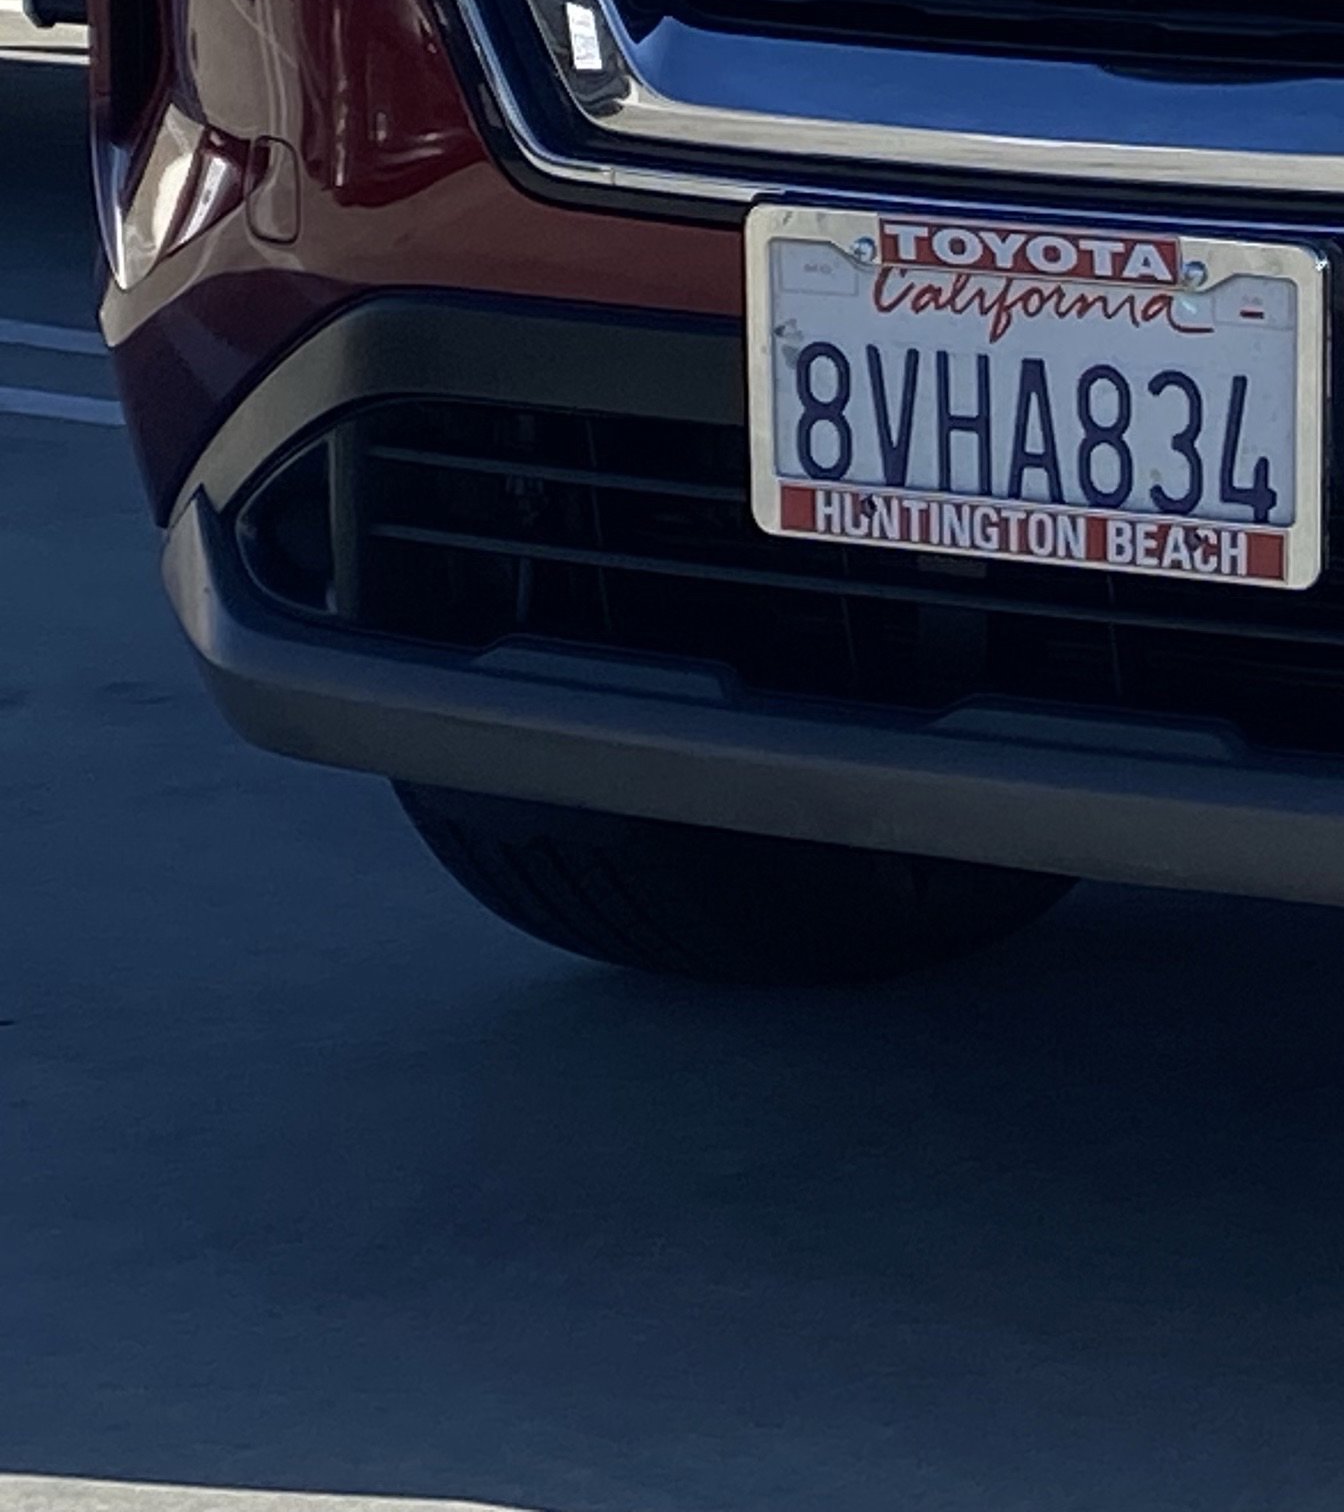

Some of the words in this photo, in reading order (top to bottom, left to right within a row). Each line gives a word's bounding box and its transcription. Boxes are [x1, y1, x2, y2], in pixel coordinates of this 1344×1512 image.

[882, 223, 1177, 282] TOYOTA
[873, 266, 1214, 344] California
[795, 340, 1278, 524] 8VHA834
[815, 490, 1088, 561] HUNTINGTON
[1106, 521, 1248, 576] BEACH
